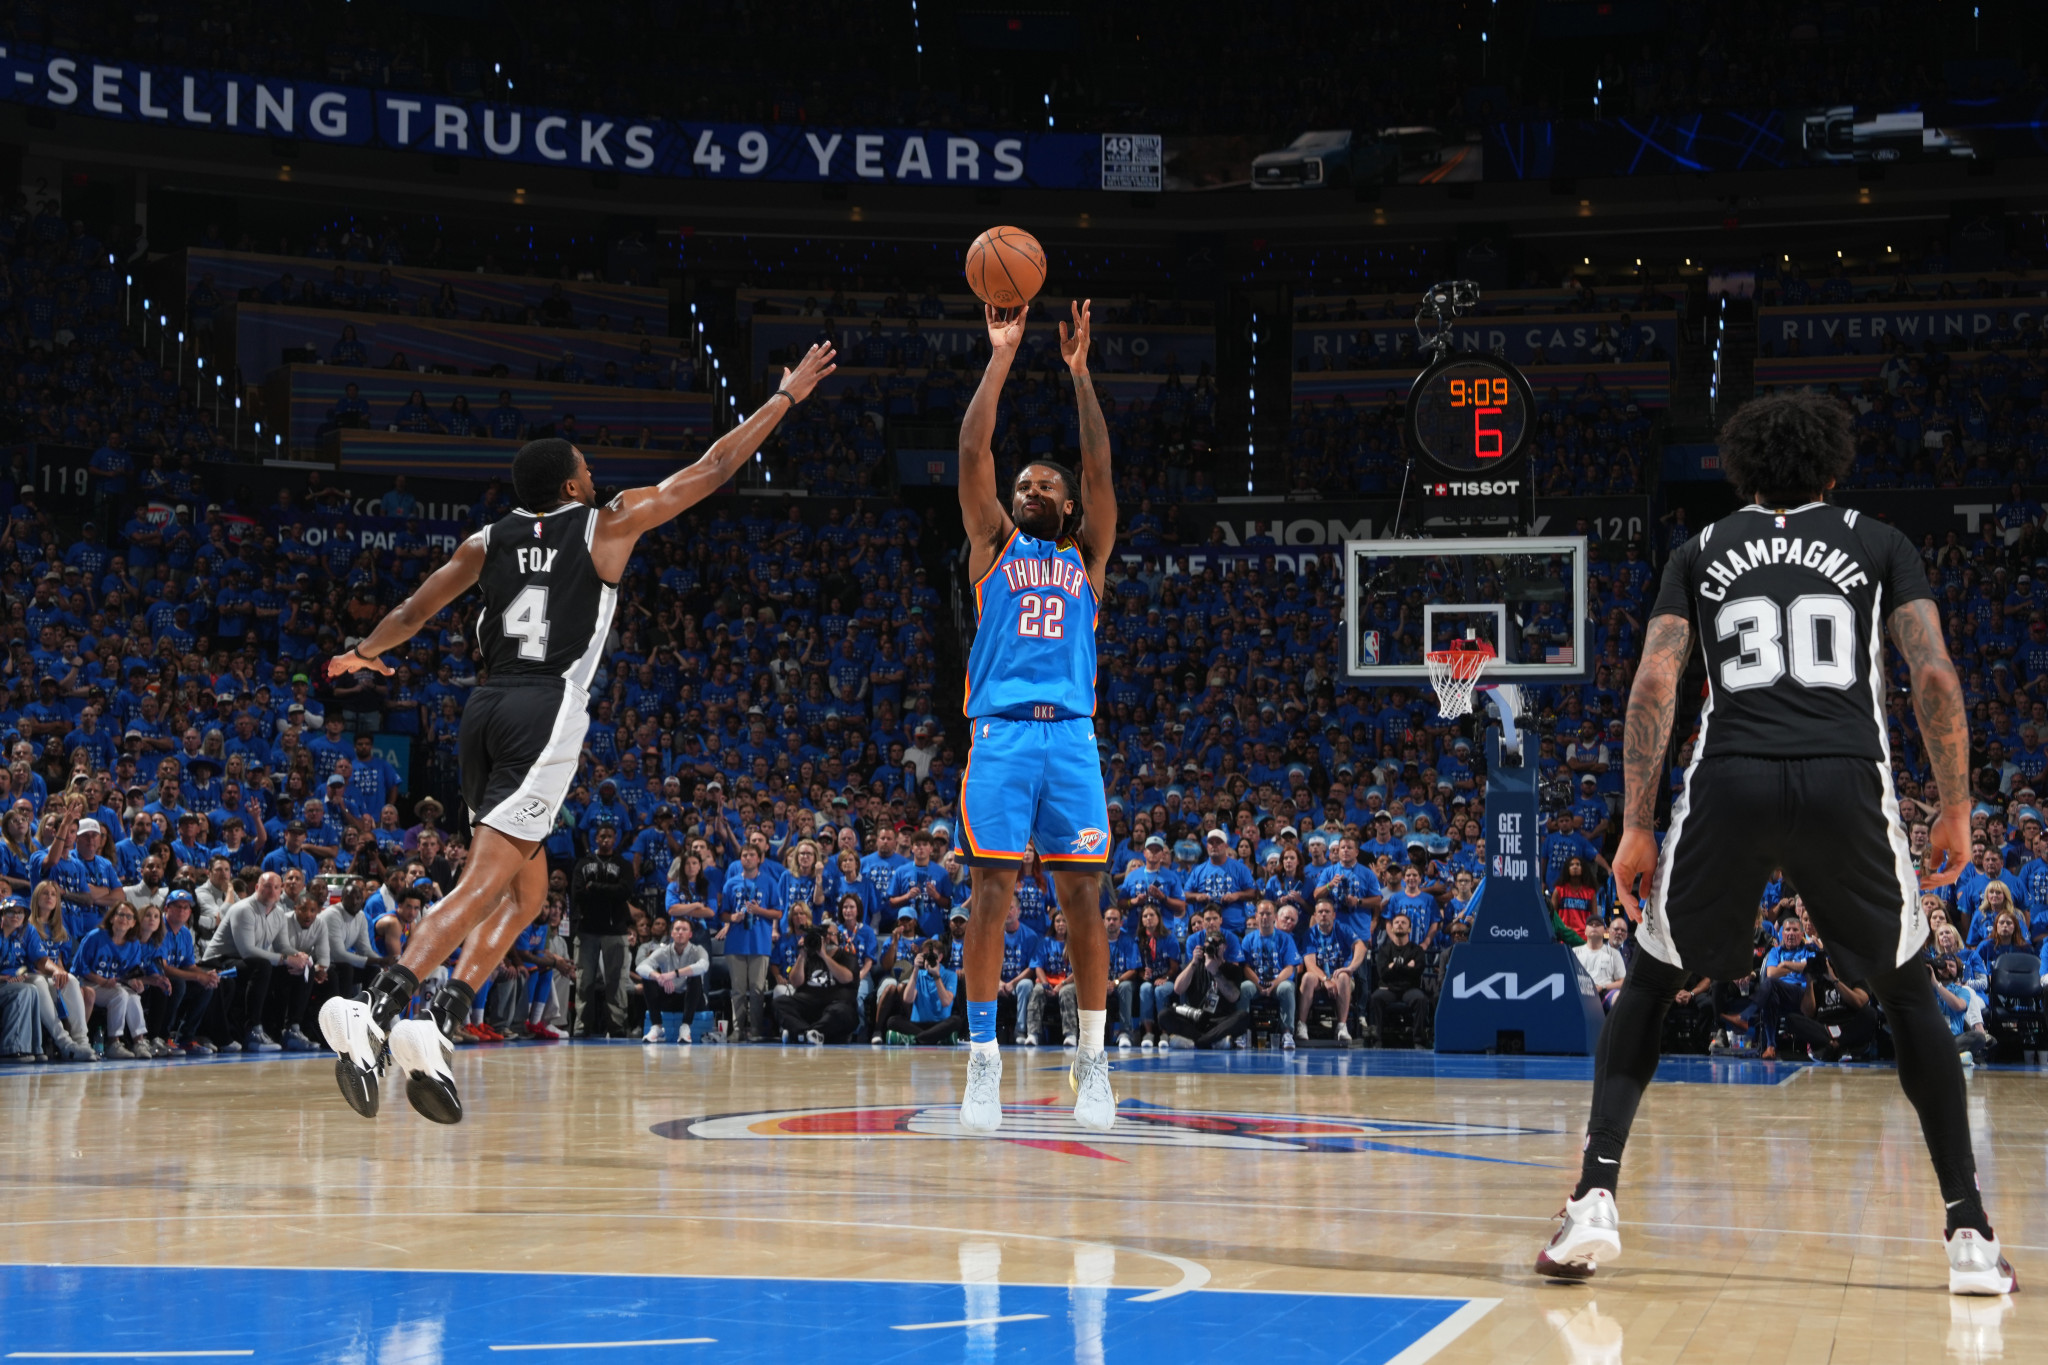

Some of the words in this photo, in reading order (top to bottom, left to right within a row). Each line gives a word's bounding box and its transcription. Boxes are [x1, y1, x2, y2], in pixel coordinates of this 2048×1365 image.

[0, 47, 347, 137] -SELLING
[386, 99, 655, 169] TRUCKS
[693, 129, 770, 174] 49
[805, 133, 1024, 182] YEARS
[1105, 138, 1131, 154] 49
[1782, 313, 1992, 340] RIVERWIND
[1450, 378, 1508, 407] 9:09
[1475, 407, 1503, 458] 6
[42, 464, 88, 496] 119
[1449, 480, 1520, 496] TISSOT
[1594, 516, 1642, 541] 120
[516, 546, 558, 574] FOX
[1700, 537, 1868, 602] CHAMPAGNIE
[1001, 557, 1085, 600] THUNDER
[502, 584, 551, 662] 4
[1018, 593, 1065, 639] 22
[1714, 593, 1857, 694] 30
[1033, 706, 1055, 719] OKC
[1498, 813, 1521, 834] GET
[1498, 834, 1522, 854] THE
[1503, 856, 1528, 881] App
[1490, 925, 1529, 940] Google
[1453, 971, 1565, 1002] KIA
[1961, 1231, 1973, 1239] 33
